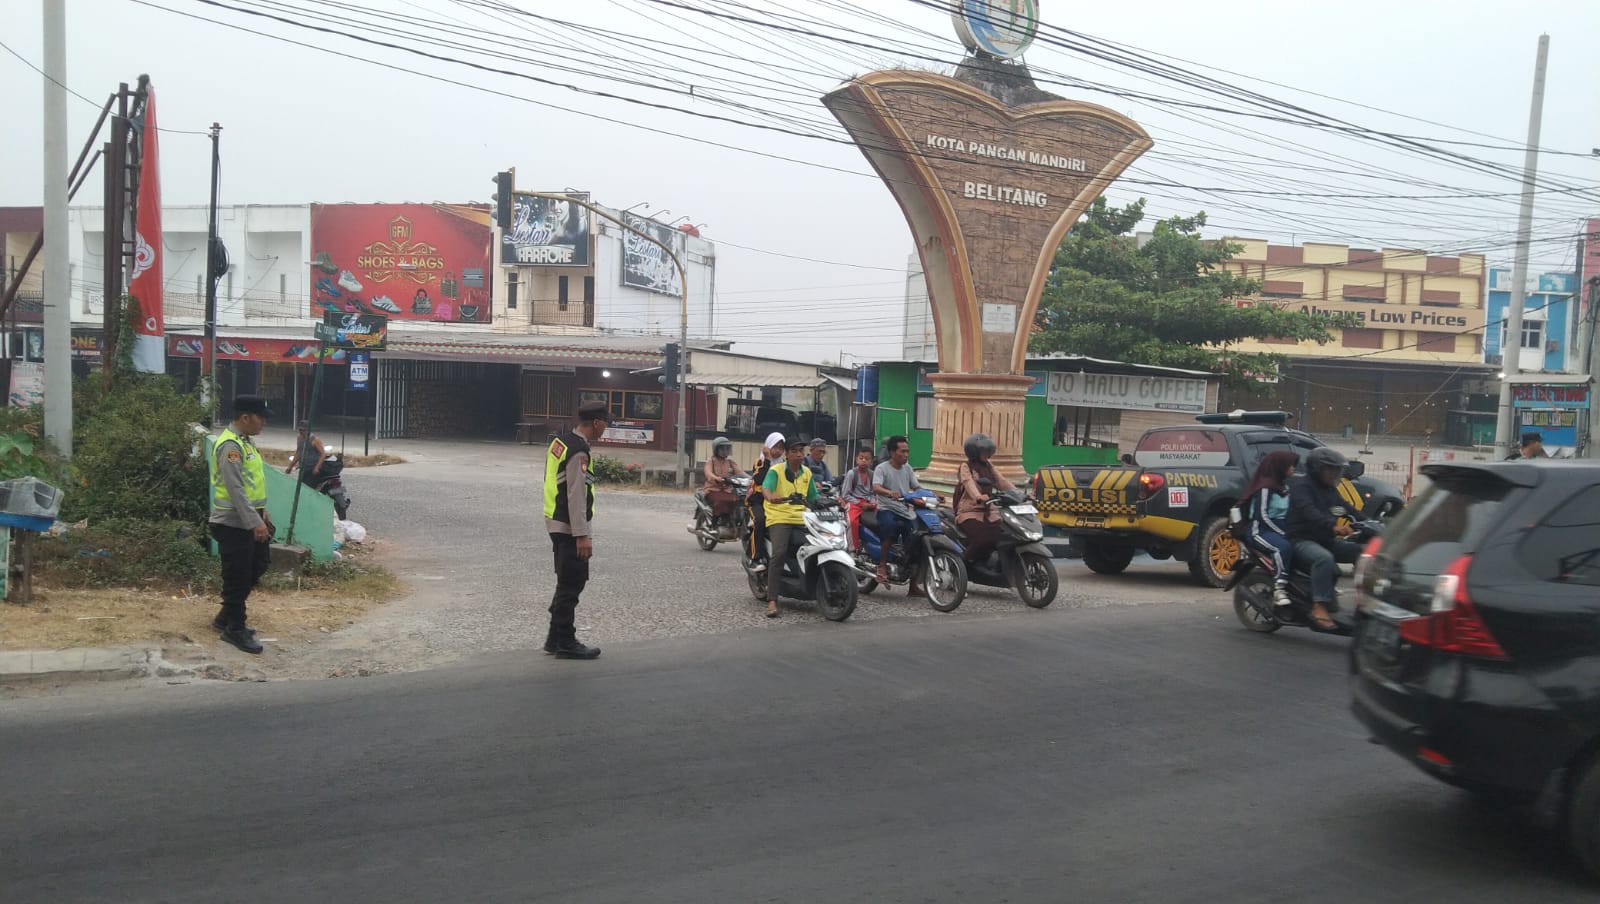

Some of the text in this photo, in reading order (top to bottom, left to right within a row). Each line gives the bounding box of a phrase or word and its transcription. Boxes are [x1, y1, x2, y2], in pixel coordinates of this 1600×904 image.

[927, 134, 965, 153] KOTA
[969, 141, 1026, 162] PANGAN
[964, 181, 1048, 208] BELITANG
[503, 203, 555, 245] Lestari
[358, 255, 396, 269] SHOES
[411, 257, 444, 270] BAGS
[518, 248, 573, 264] KARAOKE
[1370, 308, 1407, 324] Low
[1410, 310, 1467, 327] Prices
[1084, 375, 1129, 397] HALU
[1139, 378, 1206, 402] COFFEE
[1160, 443, 1179, 451] POLRI
[1165, 472, 1218, 489] PATROLI
[1043, 488, 1127, 504] POLISI
